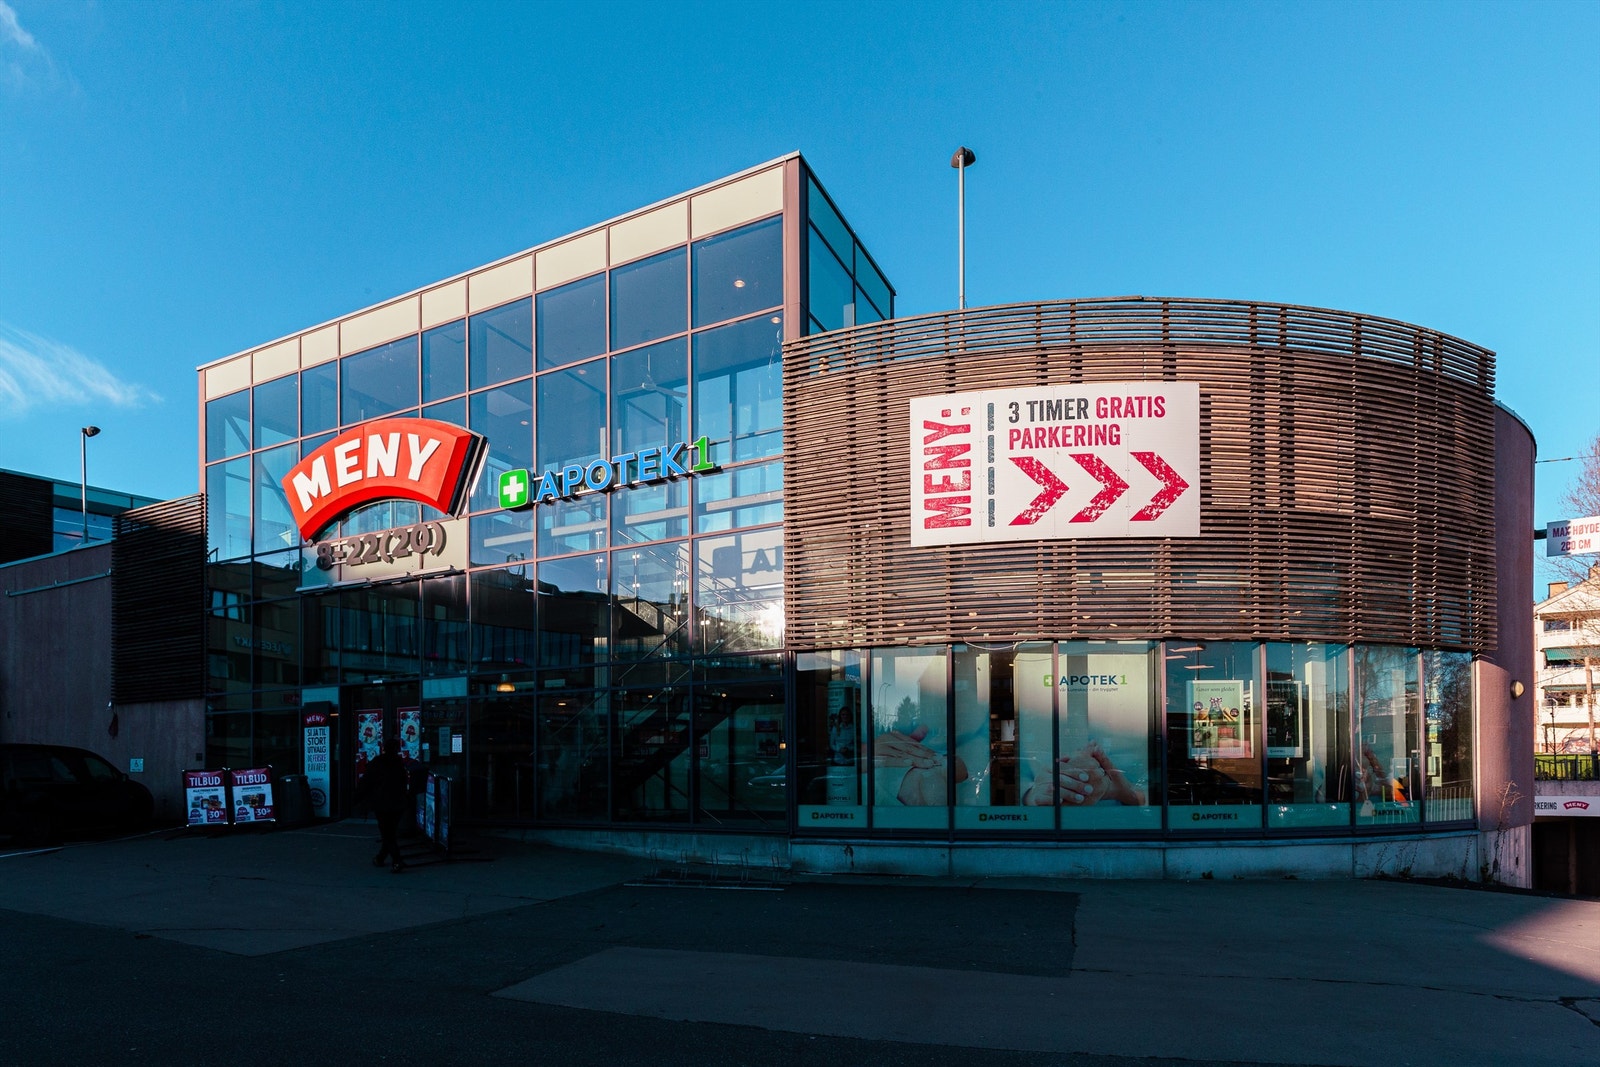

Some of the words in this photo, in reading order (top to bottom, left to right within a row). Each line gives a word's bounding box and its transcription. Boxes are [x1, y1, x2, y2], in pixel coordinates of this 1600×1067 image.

[1008, 401, 1020, 424] 3
[1026, 397, 1089, 422] TIMER
[1095, 395, 1166, 419] GRATIS
[1009, 423, 1121, 451] PARKERING
[292, 432, 442, 513] MENY
[536, 441, 686, 503] APOTEK
[692, 435, 715, 472] 1
[1552, 526, 1571, 538] MAX
[1572, 522, 1600, 536] HØYDE
[316, 522, 447, 571] 8-22(20)
[1561, 540, 1576, 552] 200
[1578, 538, 1591, 549] CM
[1059, 675, 1118, 686] APOTEK
[1120, 674, 1127, 685] 1
[306, 714, 325, 724] MENY
[308, 737, 326, 745] STORT
[189, 776, 221, 787] TILBUD
[235, 773, 267, 785] TILBUD
